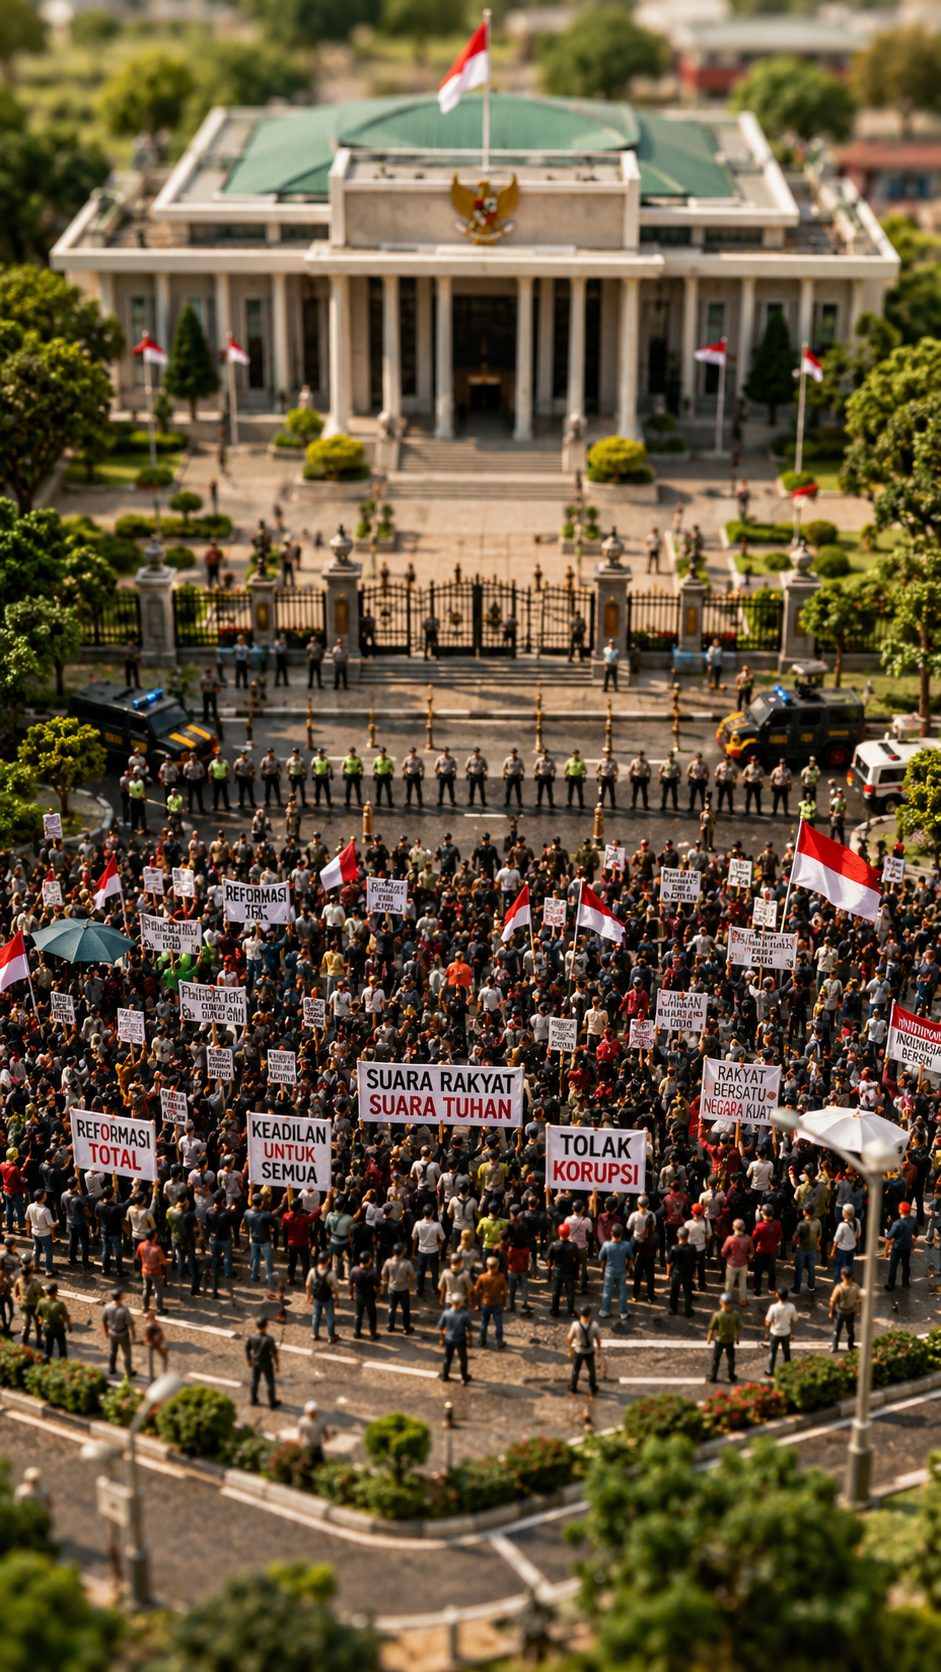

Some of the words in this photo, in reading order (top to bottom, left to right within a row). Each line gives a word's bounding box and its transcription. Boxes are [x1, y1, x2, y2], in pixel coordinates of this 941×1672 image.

[902, 1048, 932, 1067] BERSIH
[367, 1069, 433, 1091] SUARA
[441, 1072, 515, 1094] RAKYAT
[718, 1066, 766, 1084] RAKYAT
[714, 1082, 766, 1102] BERSATU
[370, 1094, 436, 1116] SUARA
[443, 1097, 511, 1119] TUHAN
[704, 1098, 743, 1117] NEGARA
[746, 1103, 773, 1120] KUAT
[77, 1119, 150, 1149] REFORMASI
[252, 1120, 326, 1144] KEADILAN
[89, 1143, 141, 1171] TOTAL
[264, 1142, 316, 1163] UNTUK
[560, 1134, 631, 1159] TOLAK
[262, 1162, 318, 1184] SEMUA
[553, 1160, 638, 1185] KORUPSI
